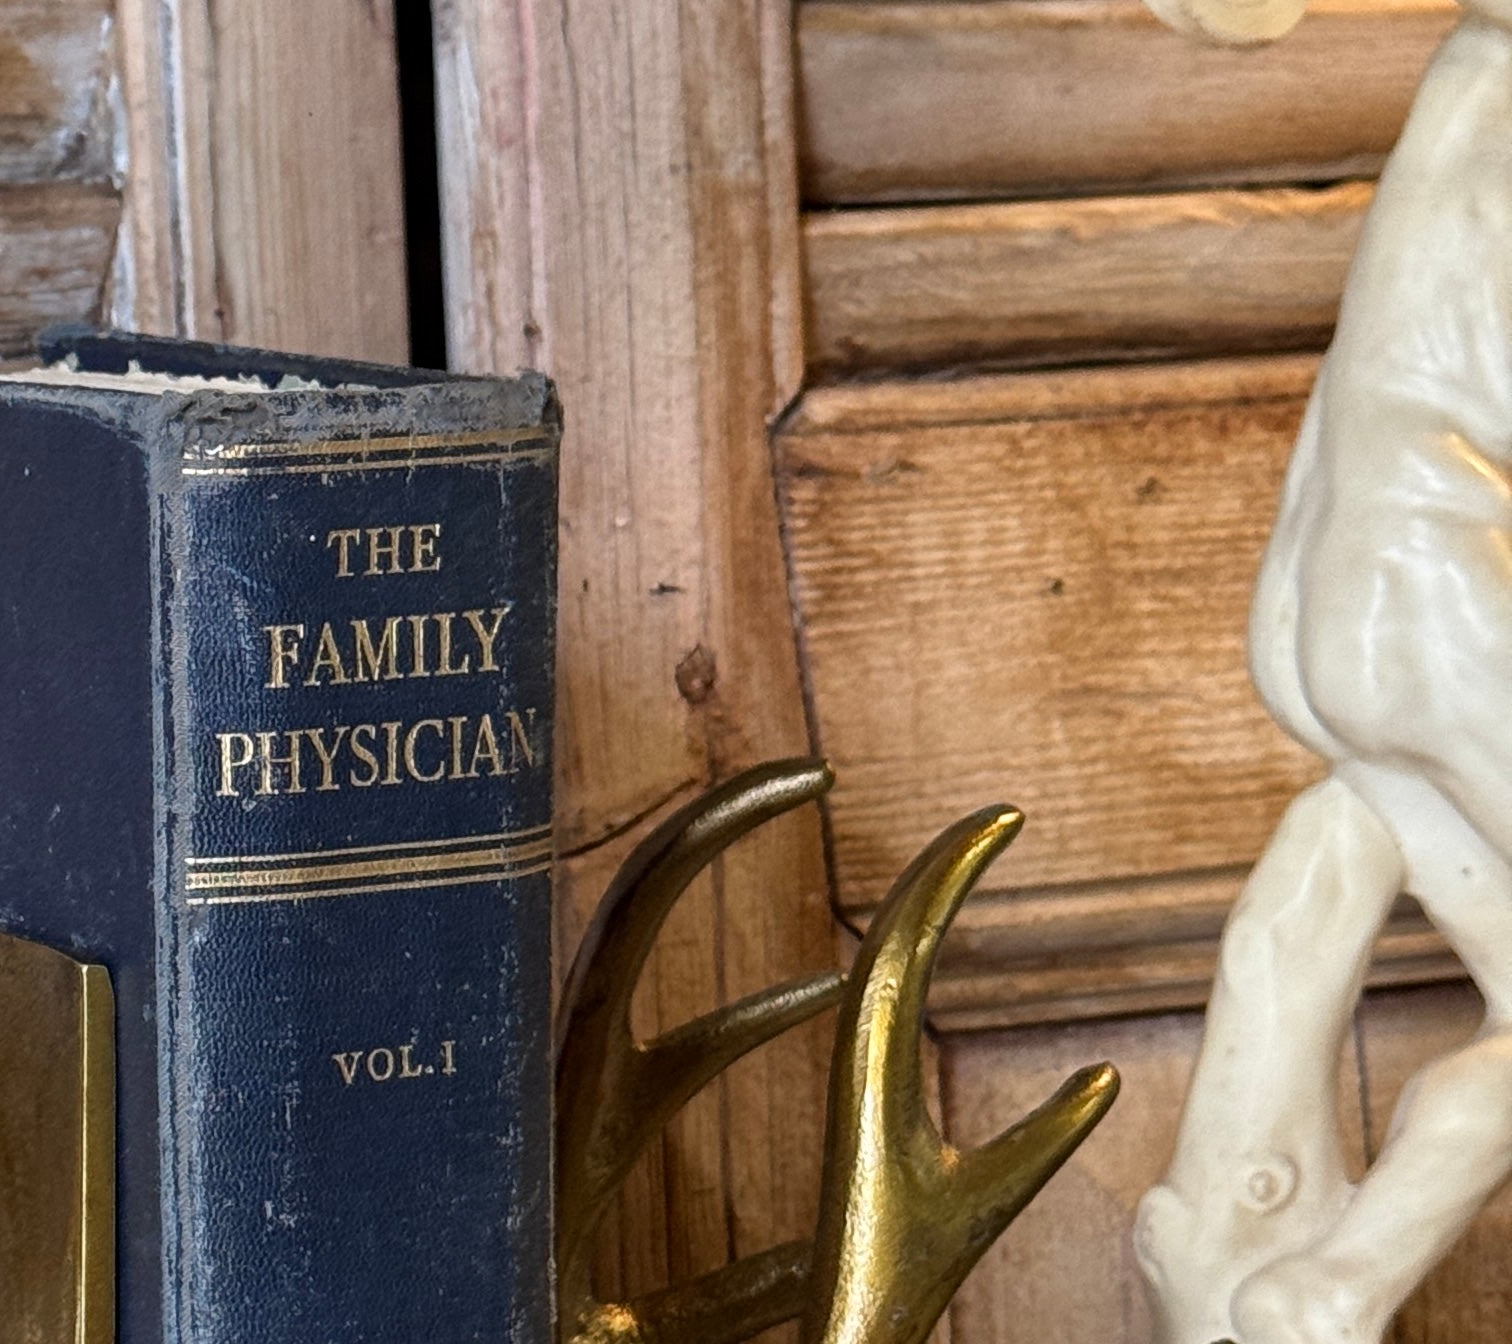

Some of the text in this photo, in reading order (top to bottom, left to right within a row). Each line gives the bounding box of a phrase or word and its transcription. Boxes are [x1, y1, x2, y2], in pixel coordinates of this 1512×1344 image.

[326, 522, 441, 578] THE
[263, 605, 513, 690] FAMILY
[214, 707, 537, 798] PHYSICIAN
